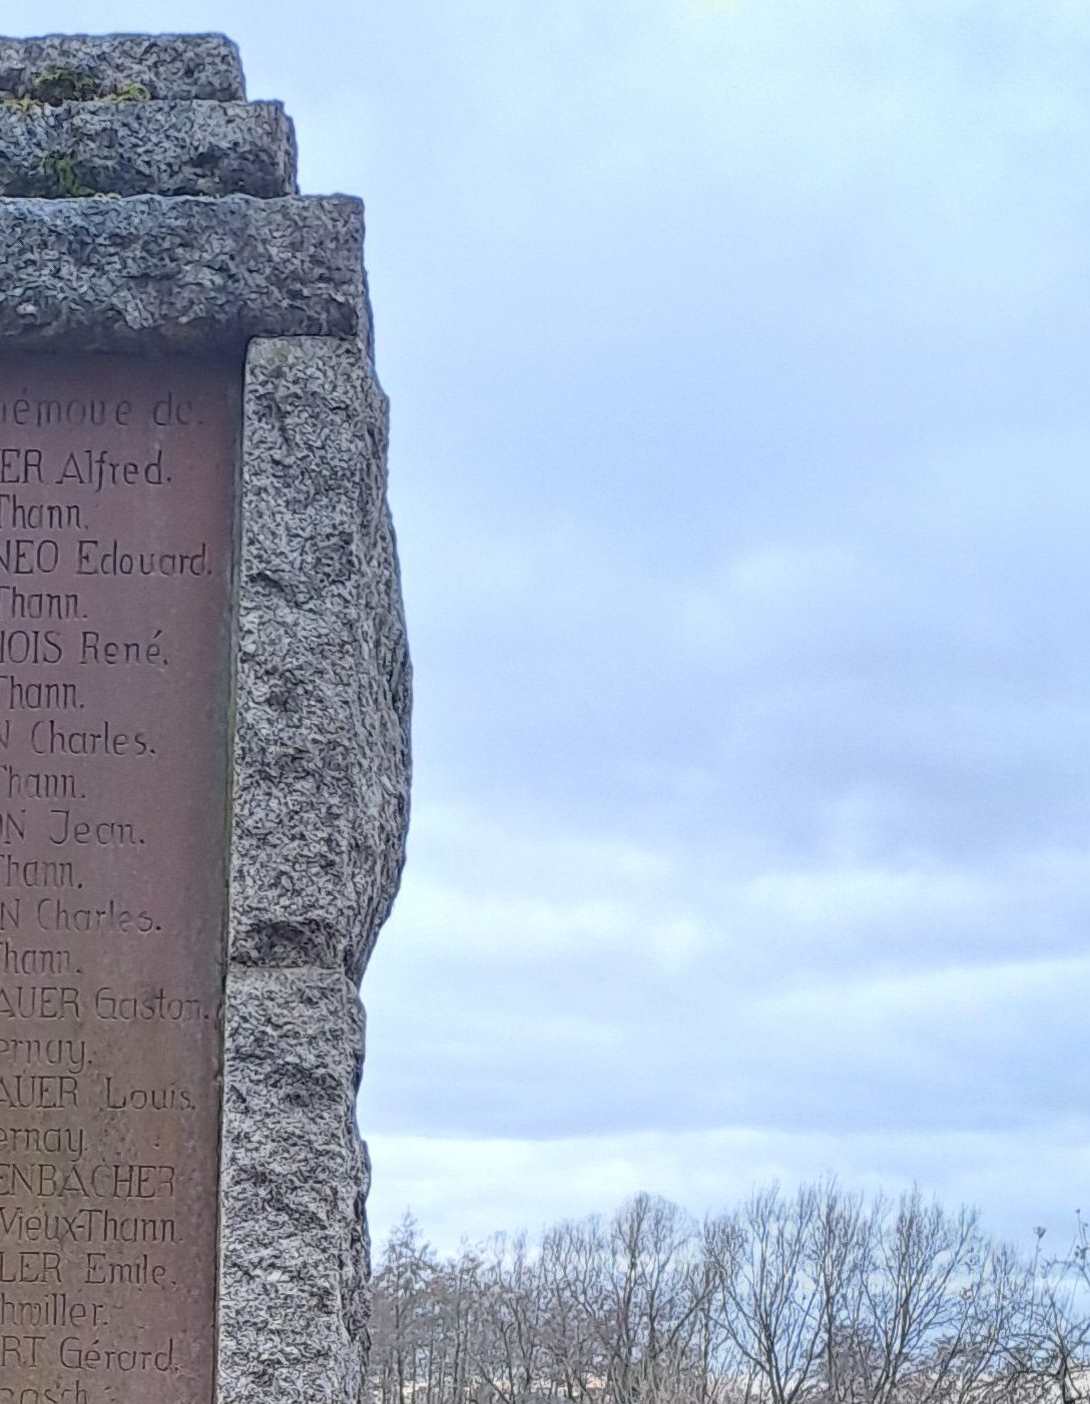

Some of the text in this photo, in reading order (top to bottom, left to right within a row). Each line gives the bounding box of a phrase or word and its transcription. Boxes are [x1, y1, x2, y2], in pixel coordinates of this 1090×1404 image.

[55, 449, 172, 493] Alfred.
[76, 540, 213, 577] Edouard.
[79, 629, 169, 667] René.
[30, 719, 157, 756] Charles.
[49, 809, 146, 846] Jean.
[37, 898, 162, 933] Charles.
[94, 987, 210, 1021] Gaston.
[103, 1076, 197, 1112] Louis.
[85, 1252, 178, 1287] Emile.
[59, 1336, 179, 1374] Gérard.
